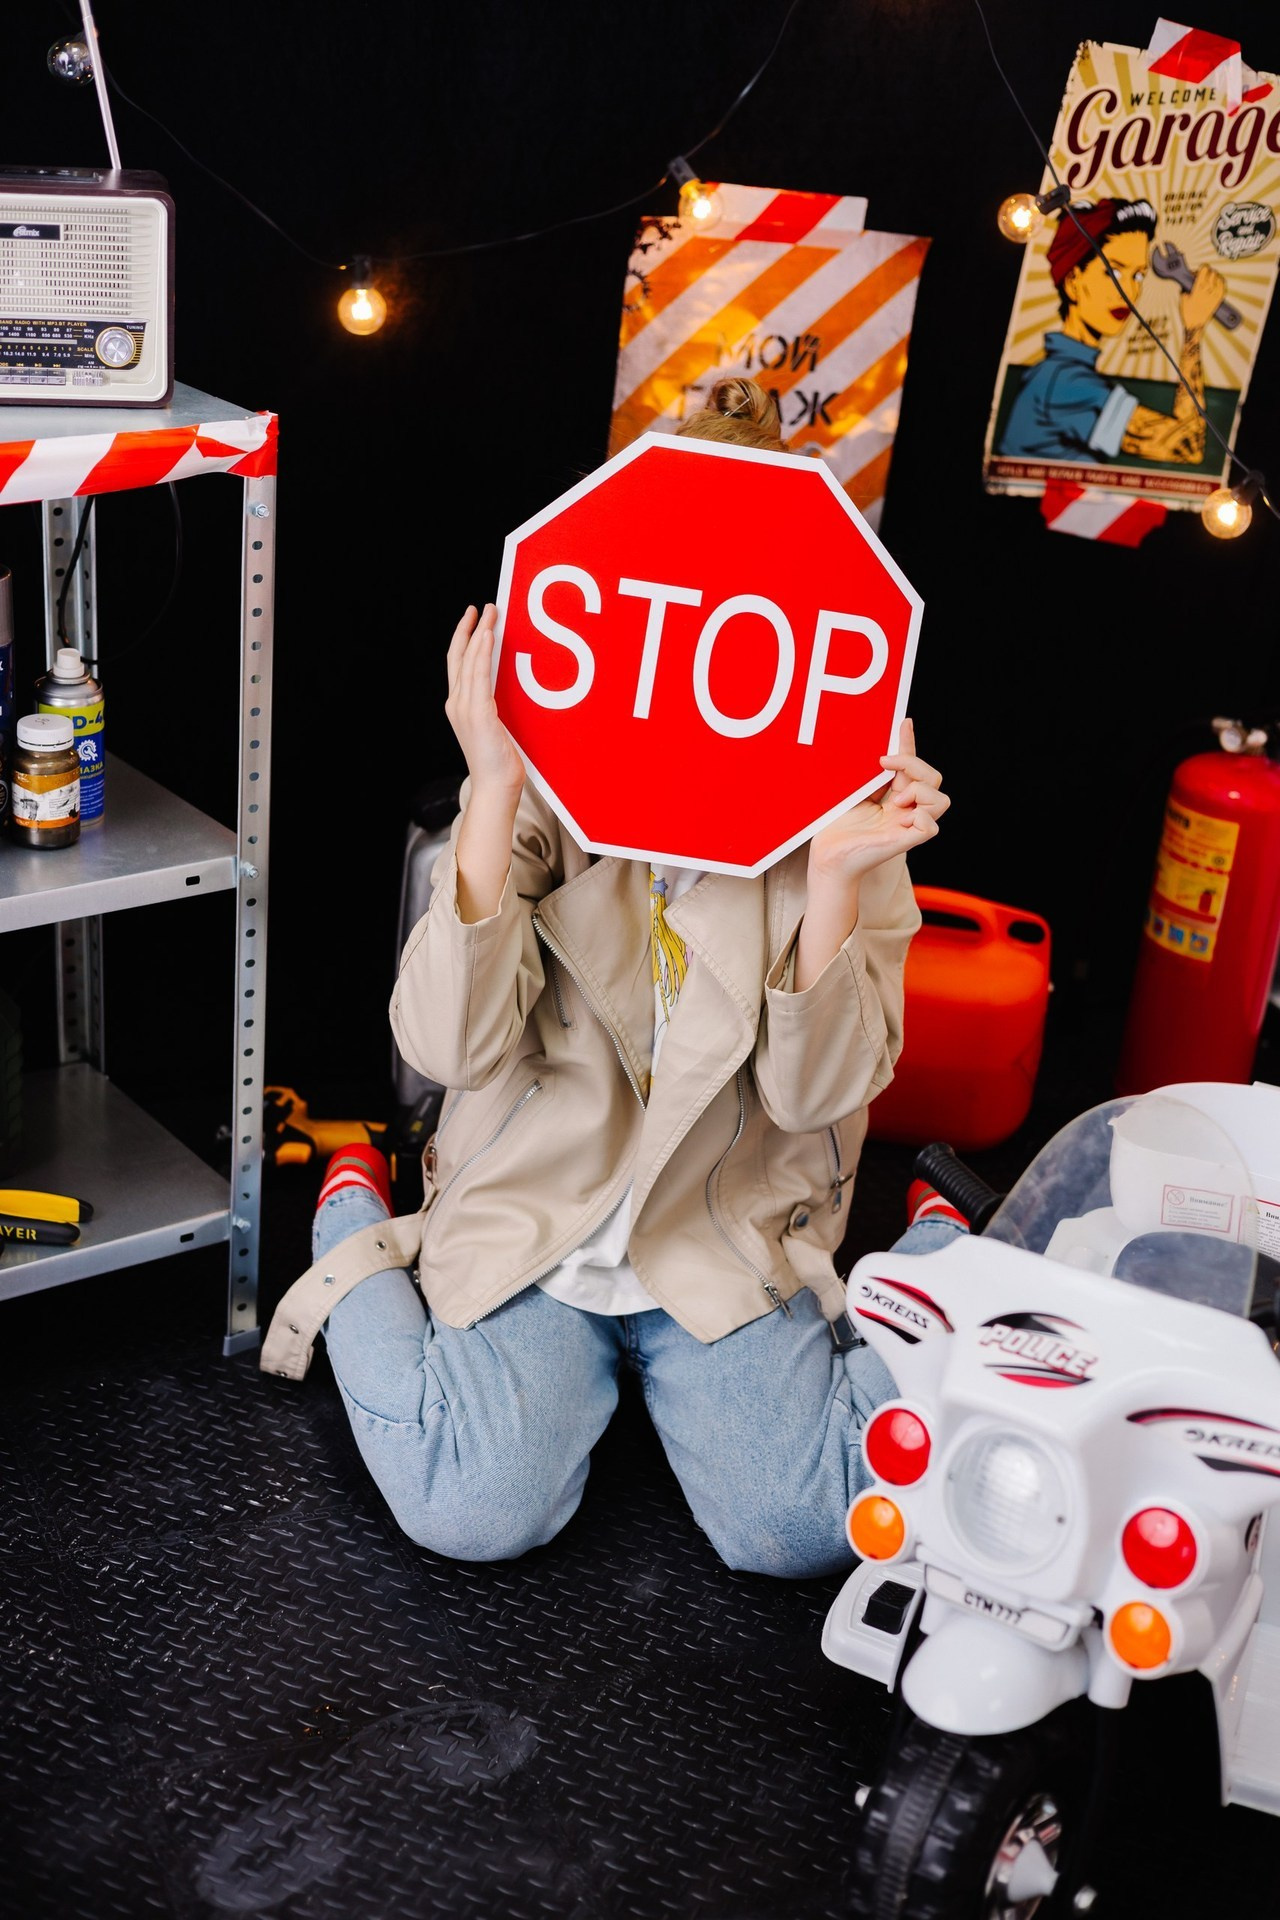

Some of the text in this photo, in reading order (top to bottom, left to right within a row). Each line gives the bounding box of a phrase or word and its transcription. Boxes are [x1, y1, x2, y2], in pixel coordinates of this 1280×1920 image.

[1130, 87, 1216, 106] WELCOME
[515, 564, 890, 746] STOP
[978, 1322, 1100, 1381] POLICE
